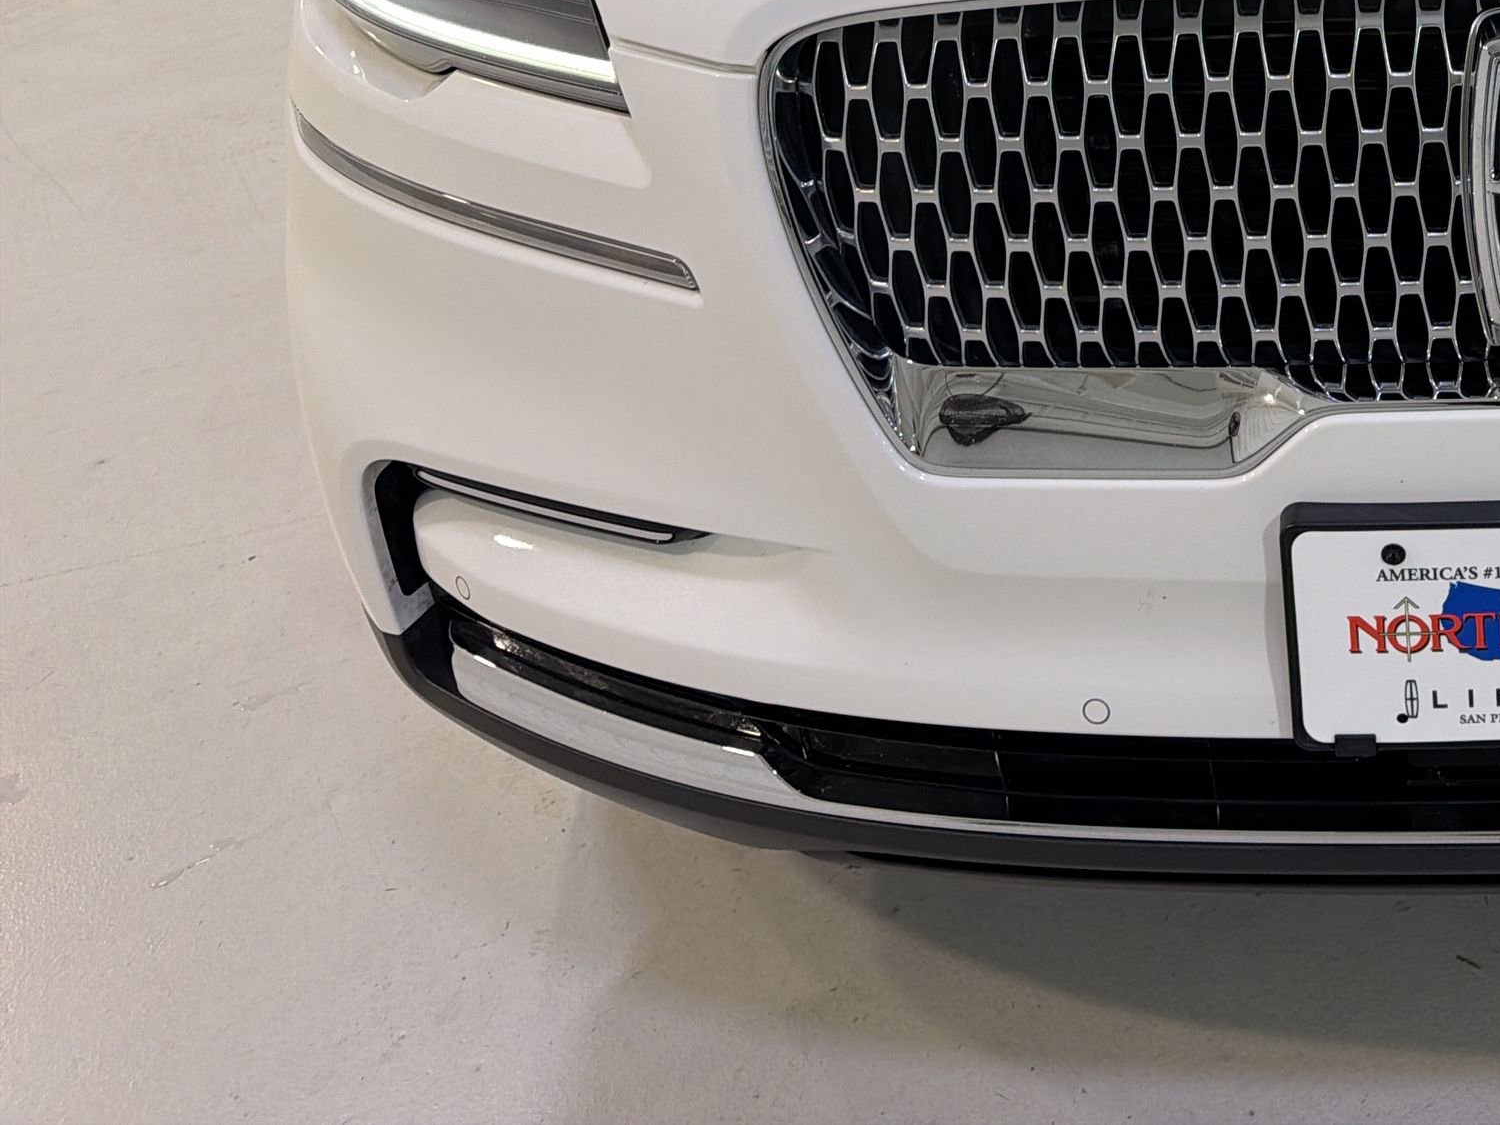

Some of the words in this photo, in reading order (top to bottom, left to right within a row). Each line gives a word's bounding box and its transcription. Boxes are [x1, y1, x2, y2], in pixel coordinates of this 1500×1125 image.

[1375, 566, 1478, 582] AMERICA'S
[1483, 566, 1500, 580] #1
[1459, 713, 1486, 725] SAN
